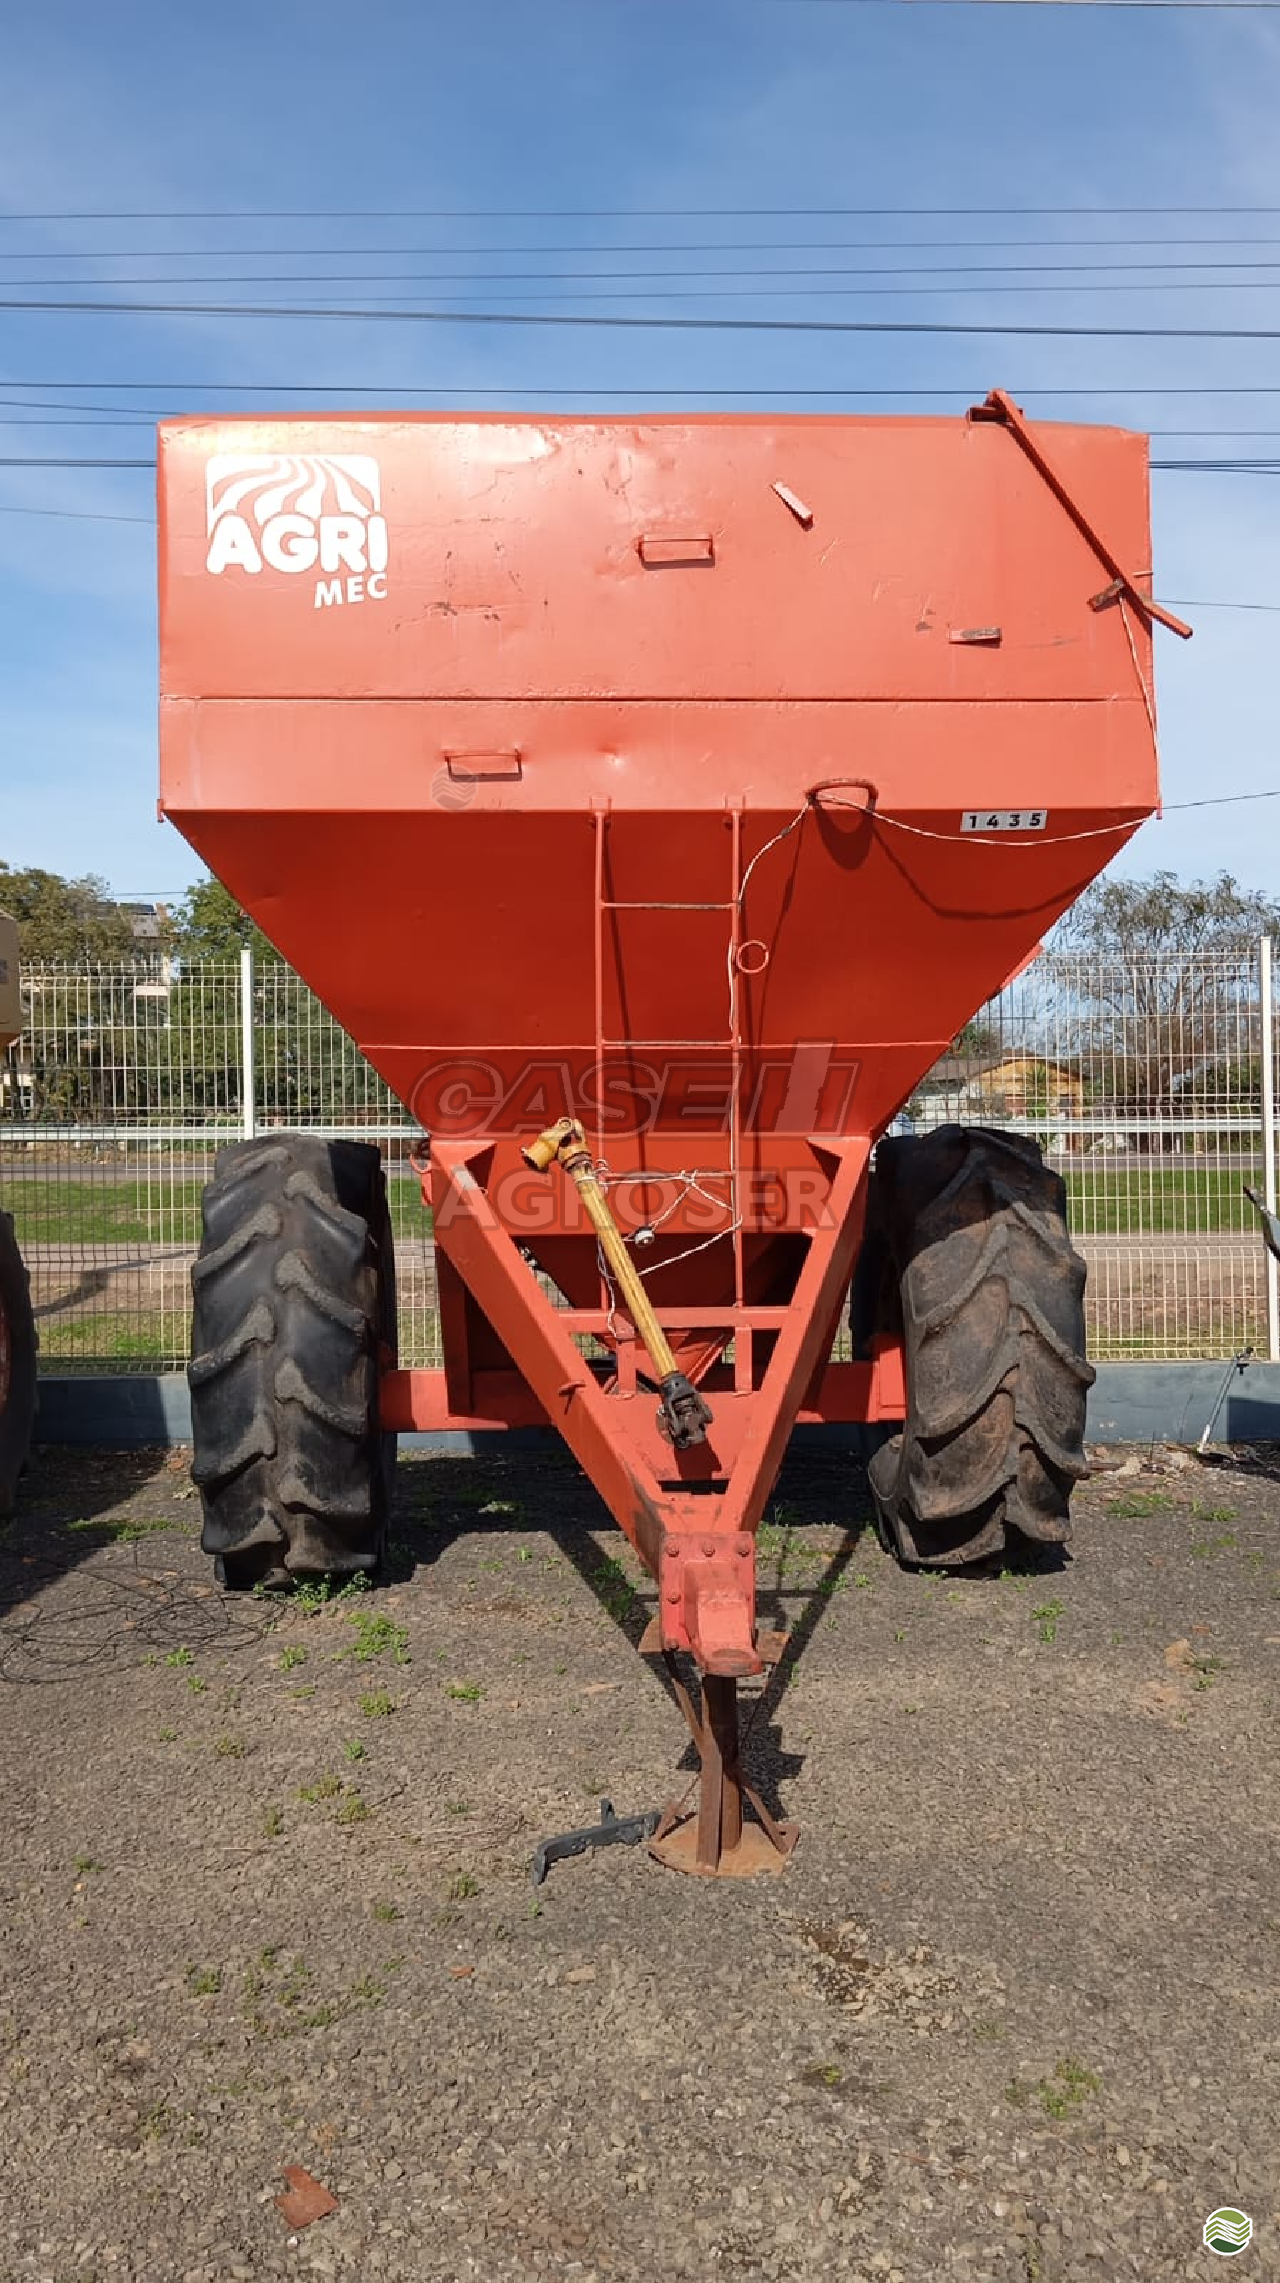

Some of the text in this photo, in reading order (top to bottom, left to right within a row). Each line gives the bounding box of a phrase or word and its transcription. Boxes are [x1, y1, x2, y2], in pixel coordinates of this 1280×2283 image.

[206, 514, 389, 574] AGRI
[313, 573, 388, 609] MEC
[968, 812, 1043, 830] 1435
